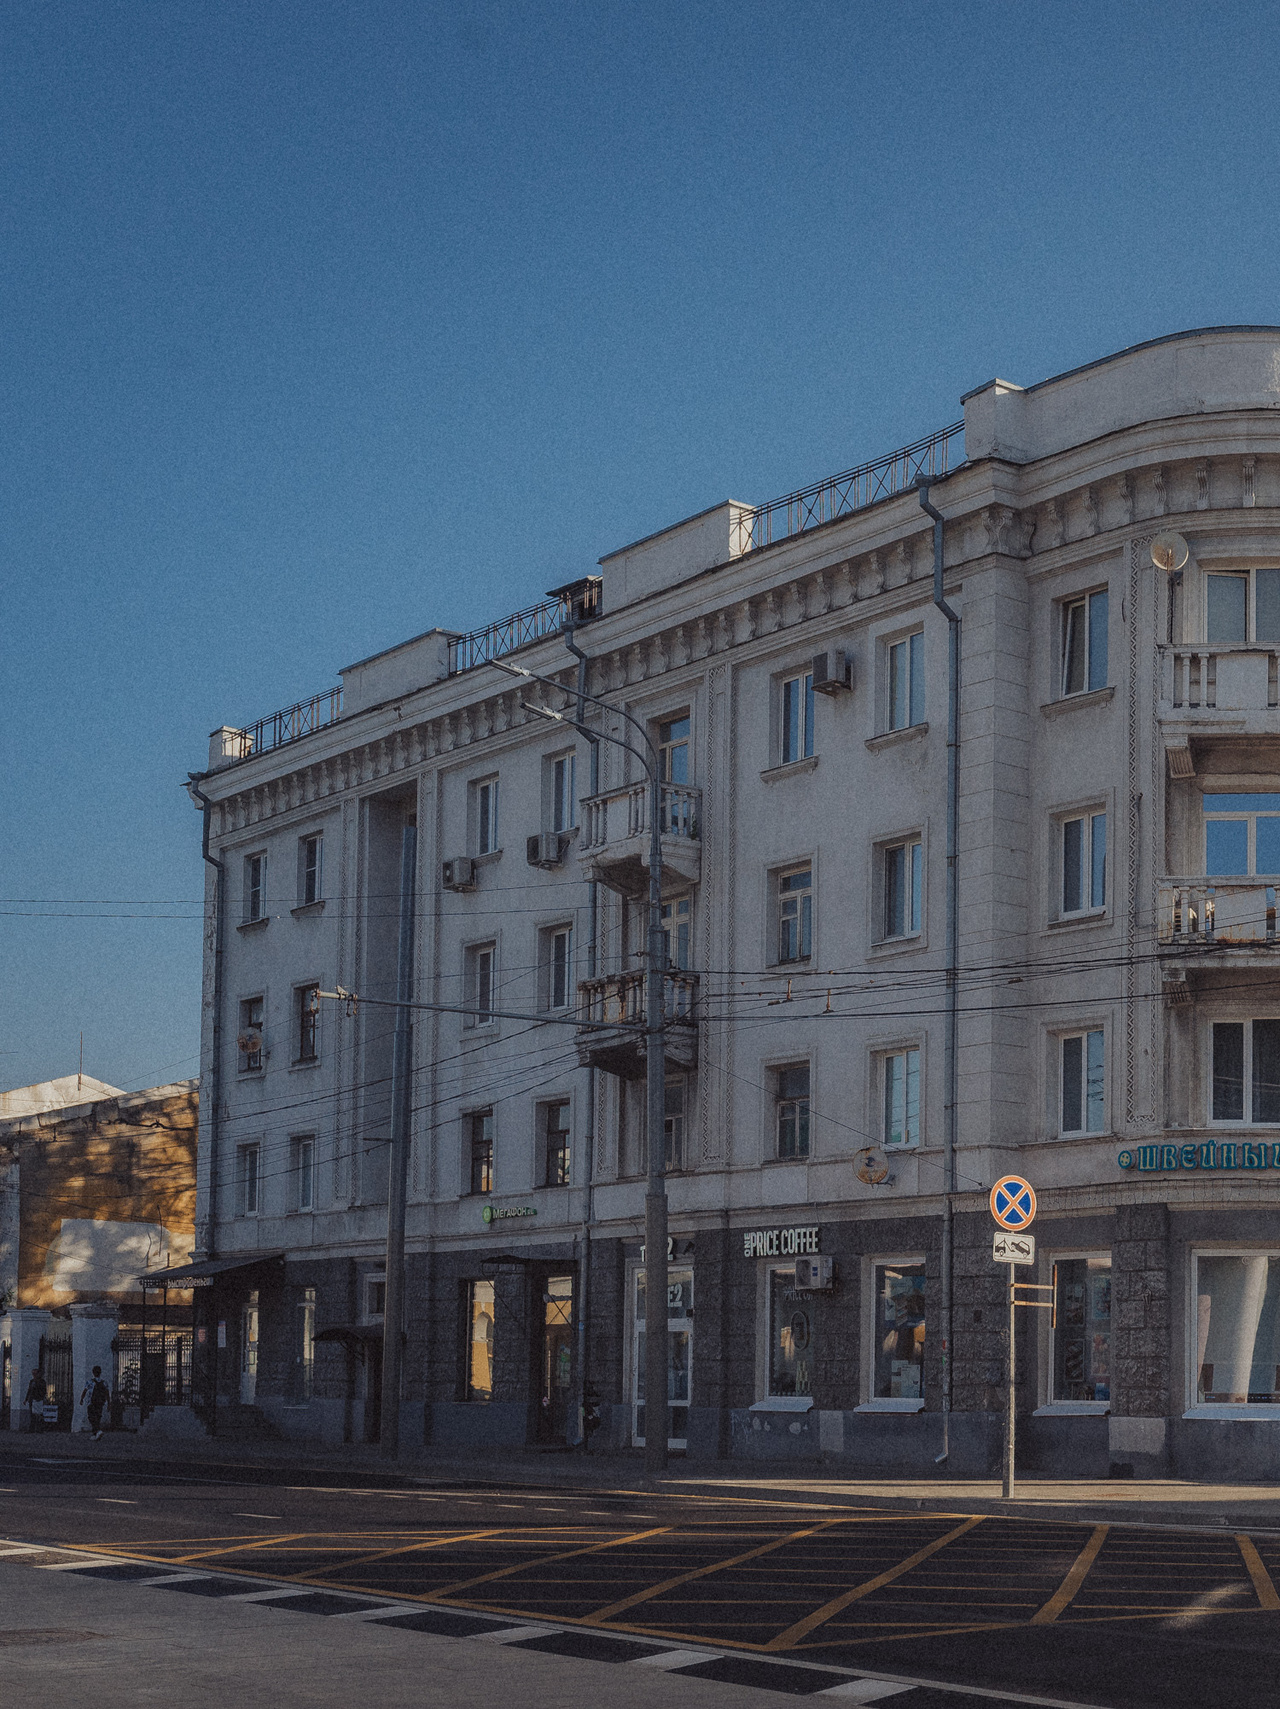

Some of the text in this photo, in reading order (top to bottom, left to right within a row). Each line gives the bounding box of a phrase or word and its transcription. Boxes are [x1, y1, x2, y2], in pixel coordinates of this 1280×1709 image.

[493, 1207, 526, 1219] МЕГАФОН
[750, 1230, 779, 1257] PRICE
[781, 1227, 819, 1255] COFFEE
